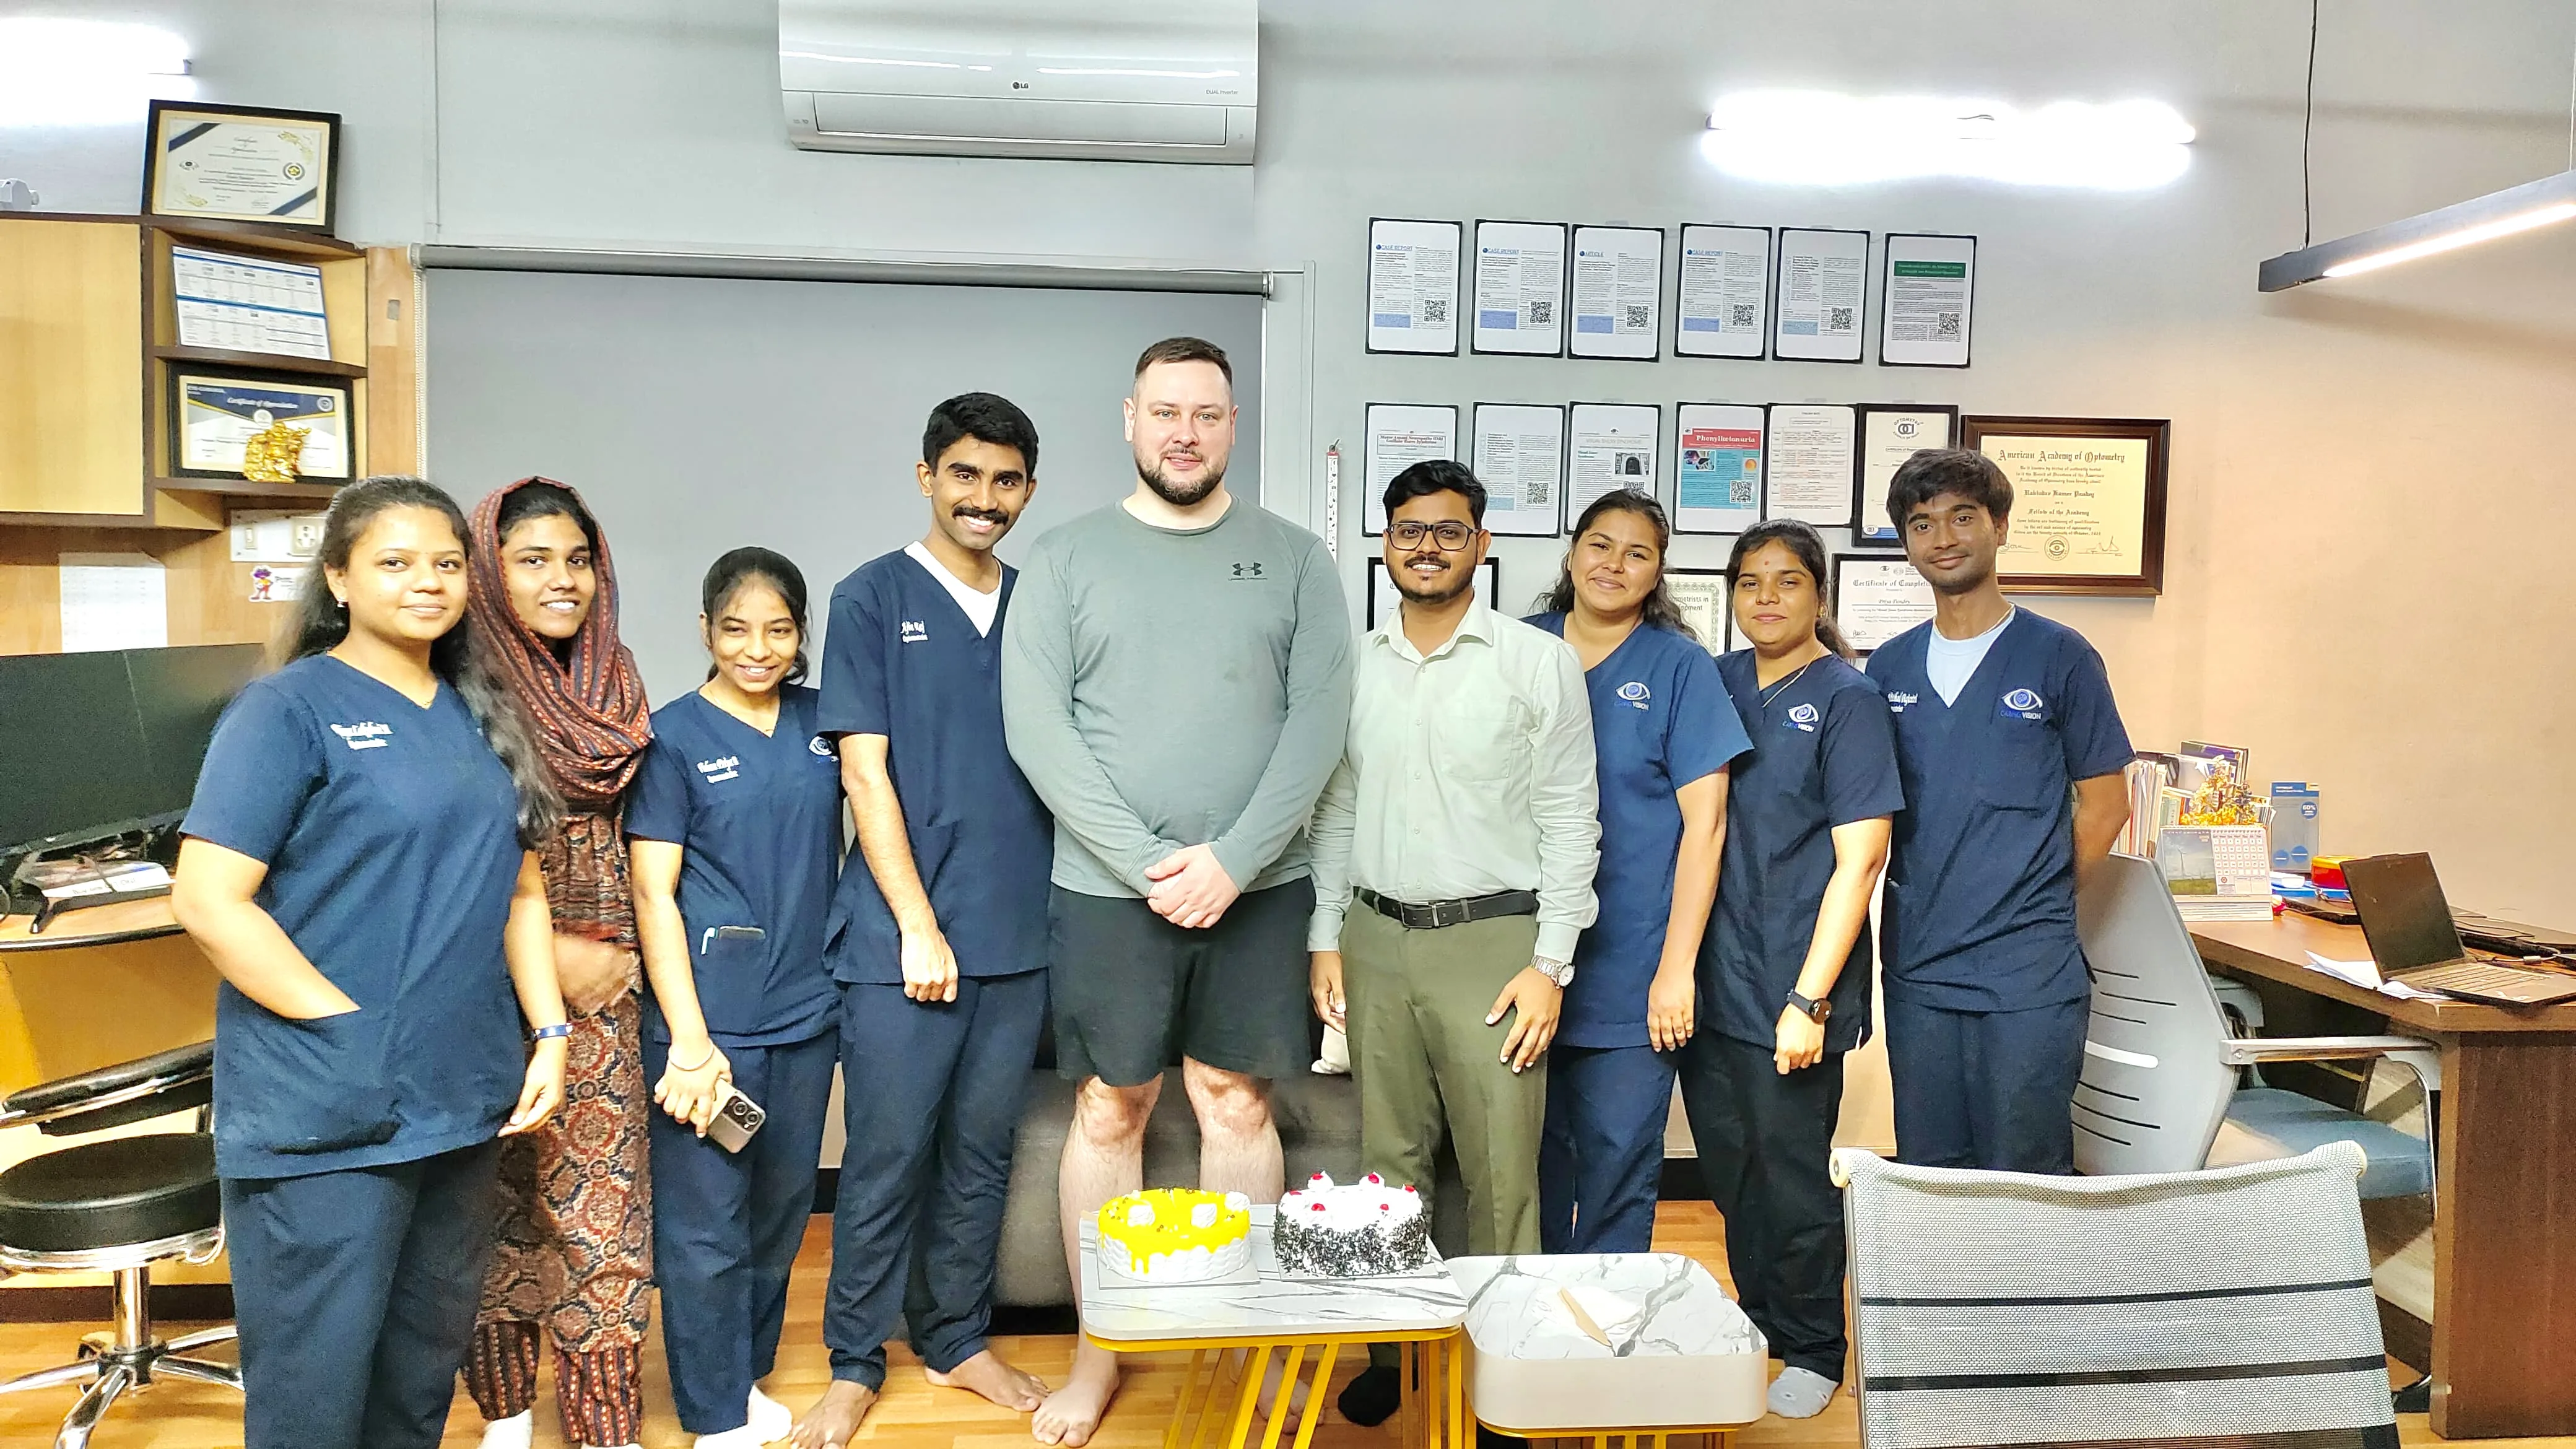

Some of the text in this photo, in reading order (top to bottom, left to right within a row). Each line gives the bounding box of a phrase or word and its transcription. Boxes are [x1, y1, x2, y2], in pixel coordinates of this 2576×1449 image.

[1997, 450, 2125, 463] American Academy of Optometry
[1899, 580, 1931, 588] Completi
[2021, 711, 2042, 720] VISION
